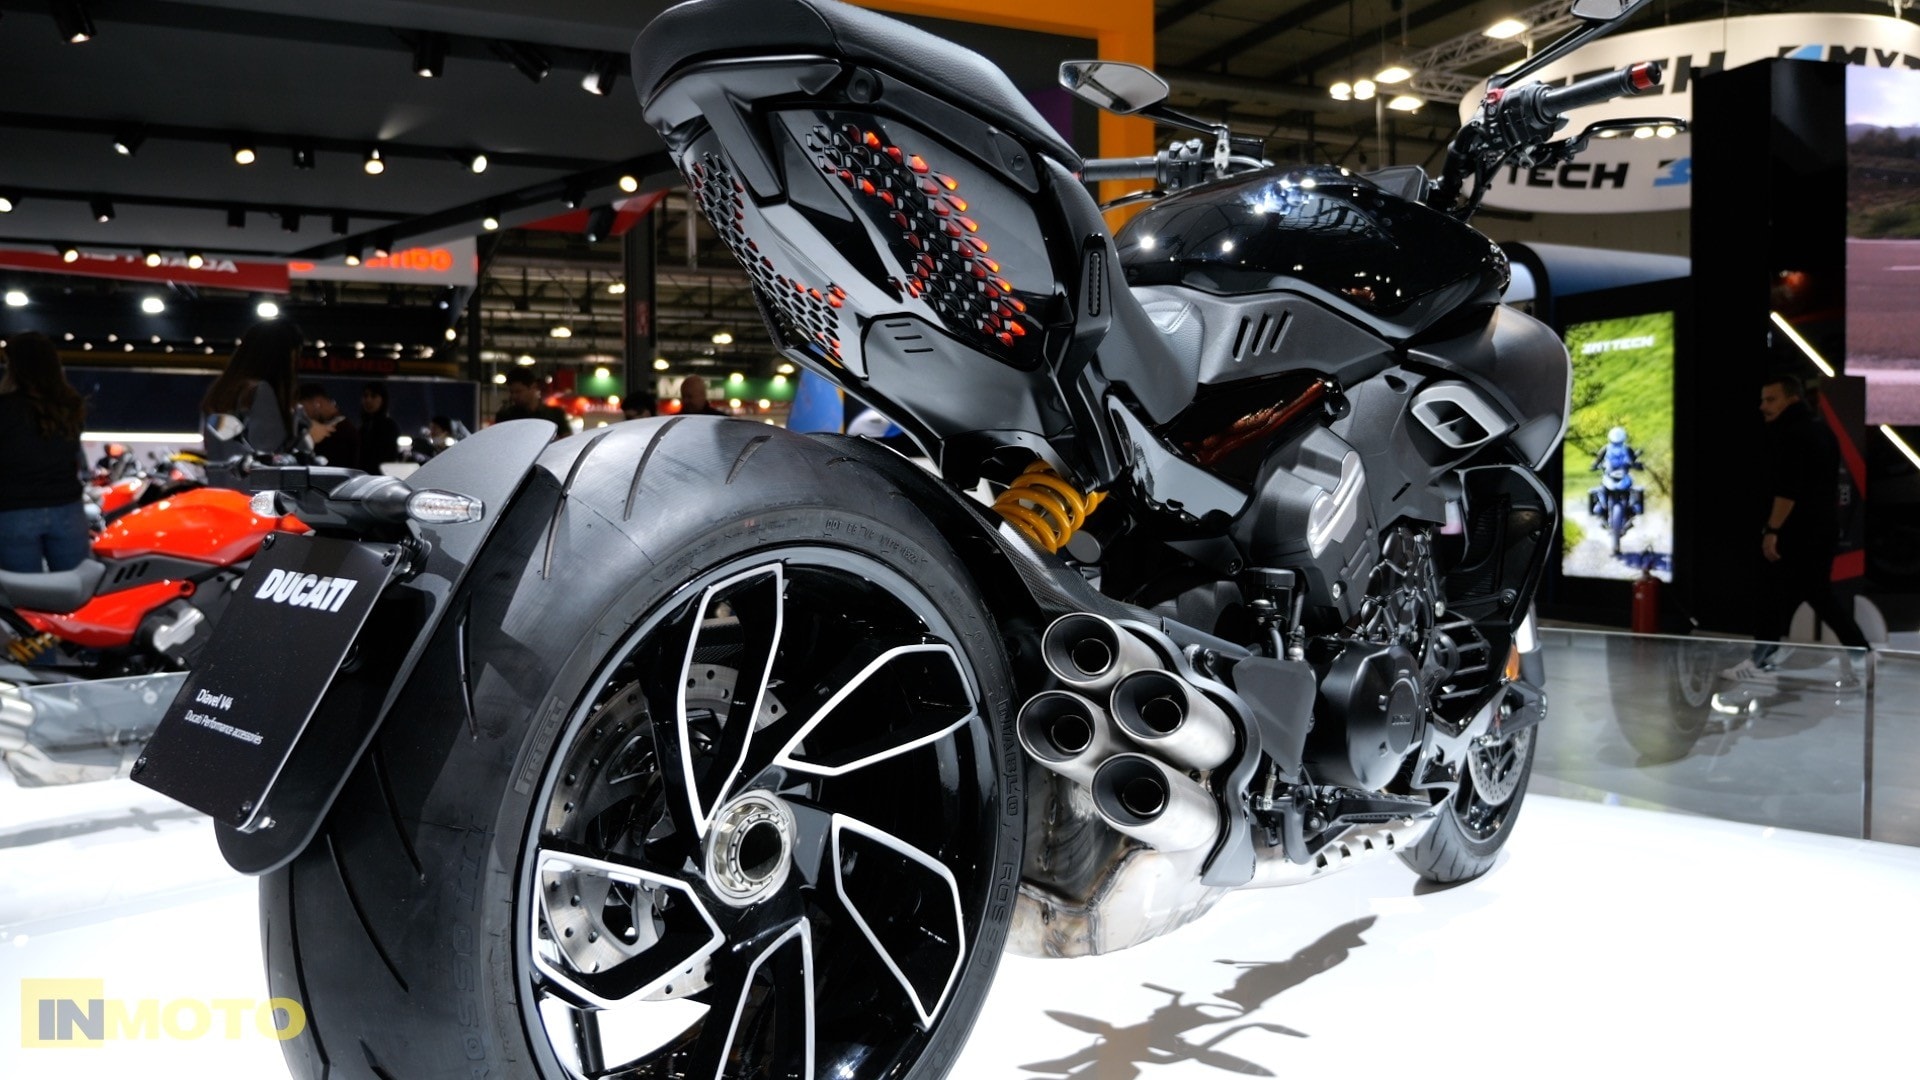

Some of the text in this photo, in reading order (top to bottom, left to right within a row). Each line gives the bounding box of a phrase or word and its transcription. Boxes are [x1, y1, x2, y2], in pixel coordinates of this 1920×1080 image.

[255, 568, 358, 613] DUCATI
[195, 688, 234, 711] Diavel V4
[184, 709, 264, 745] Ducati Performance accessories
